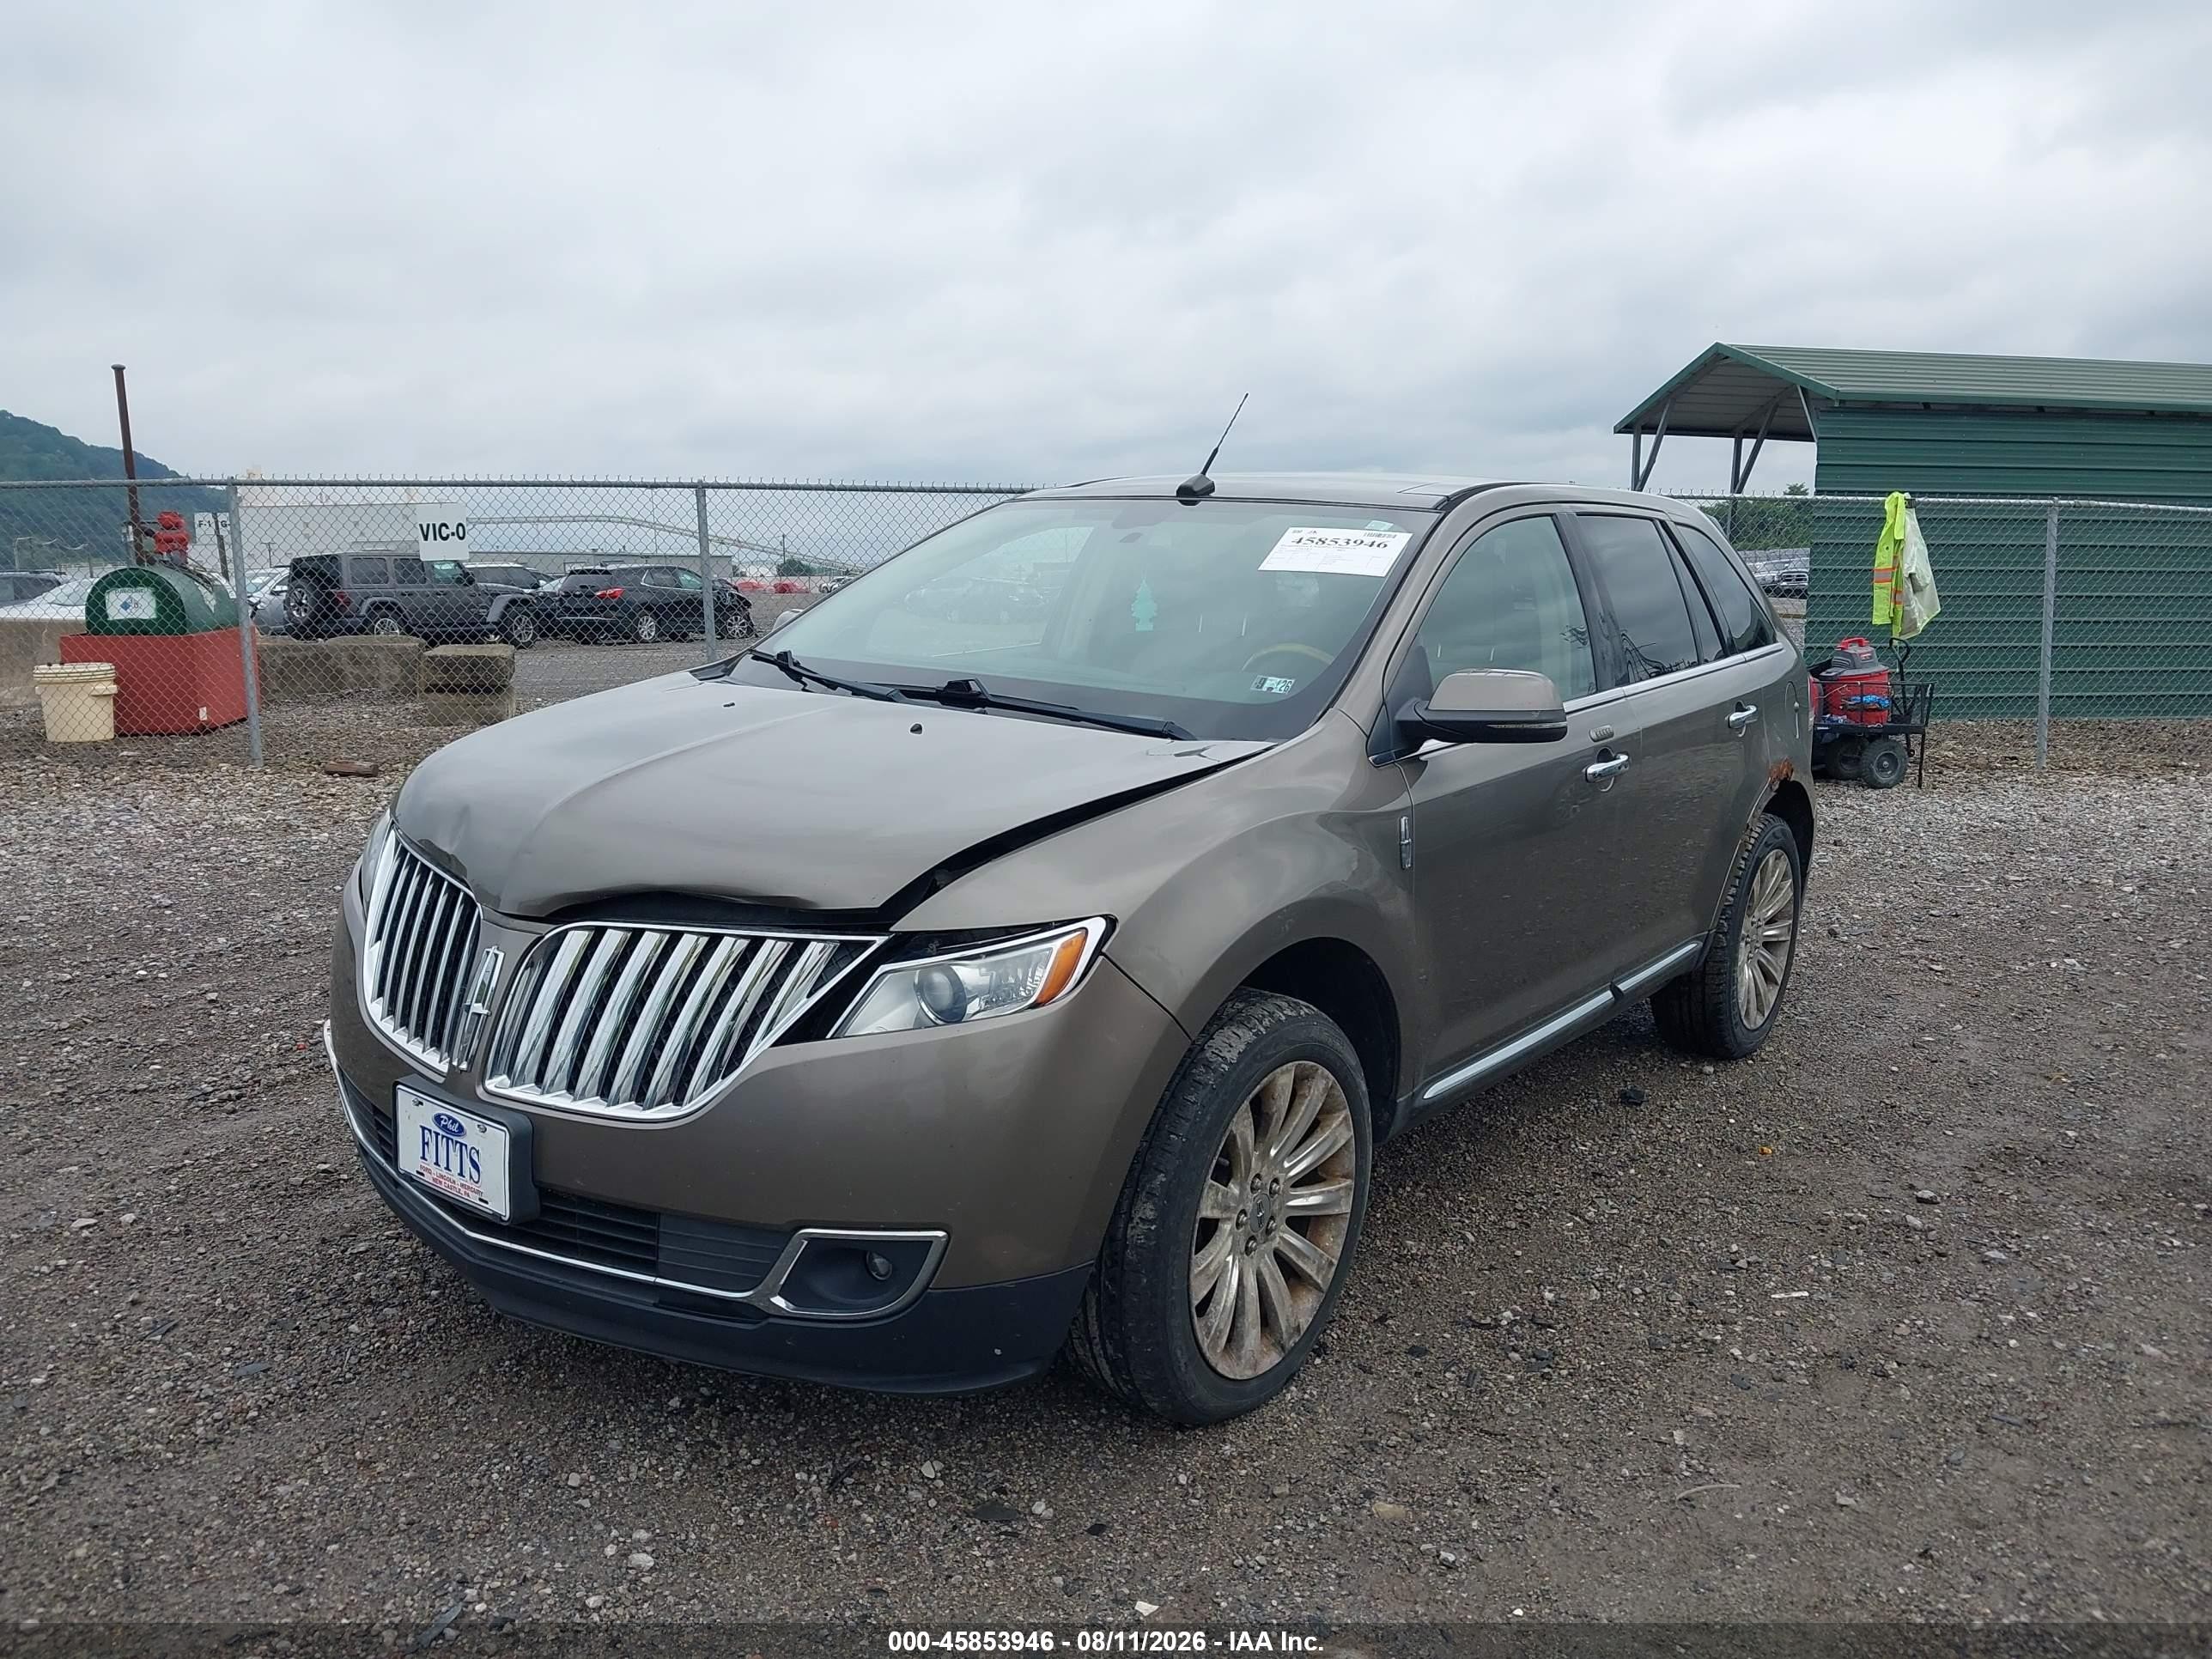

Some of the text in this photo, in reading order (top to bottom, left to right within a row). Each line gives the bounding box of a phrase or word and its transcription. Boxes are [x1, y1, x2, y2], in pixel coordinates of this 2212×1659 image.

[1291, 536, 1389, 550] 45853946
[440, 1115, 459, 1133] Phil
[419, 1125, 482, 1184] FITTS
[419, 1164, 432, 1176] FORD
[435, 1171, 456, 1185] LINCOLN
[460, 1182, 483, 1197] MERCURY
[432, 1176, 442, 1186] NEW
